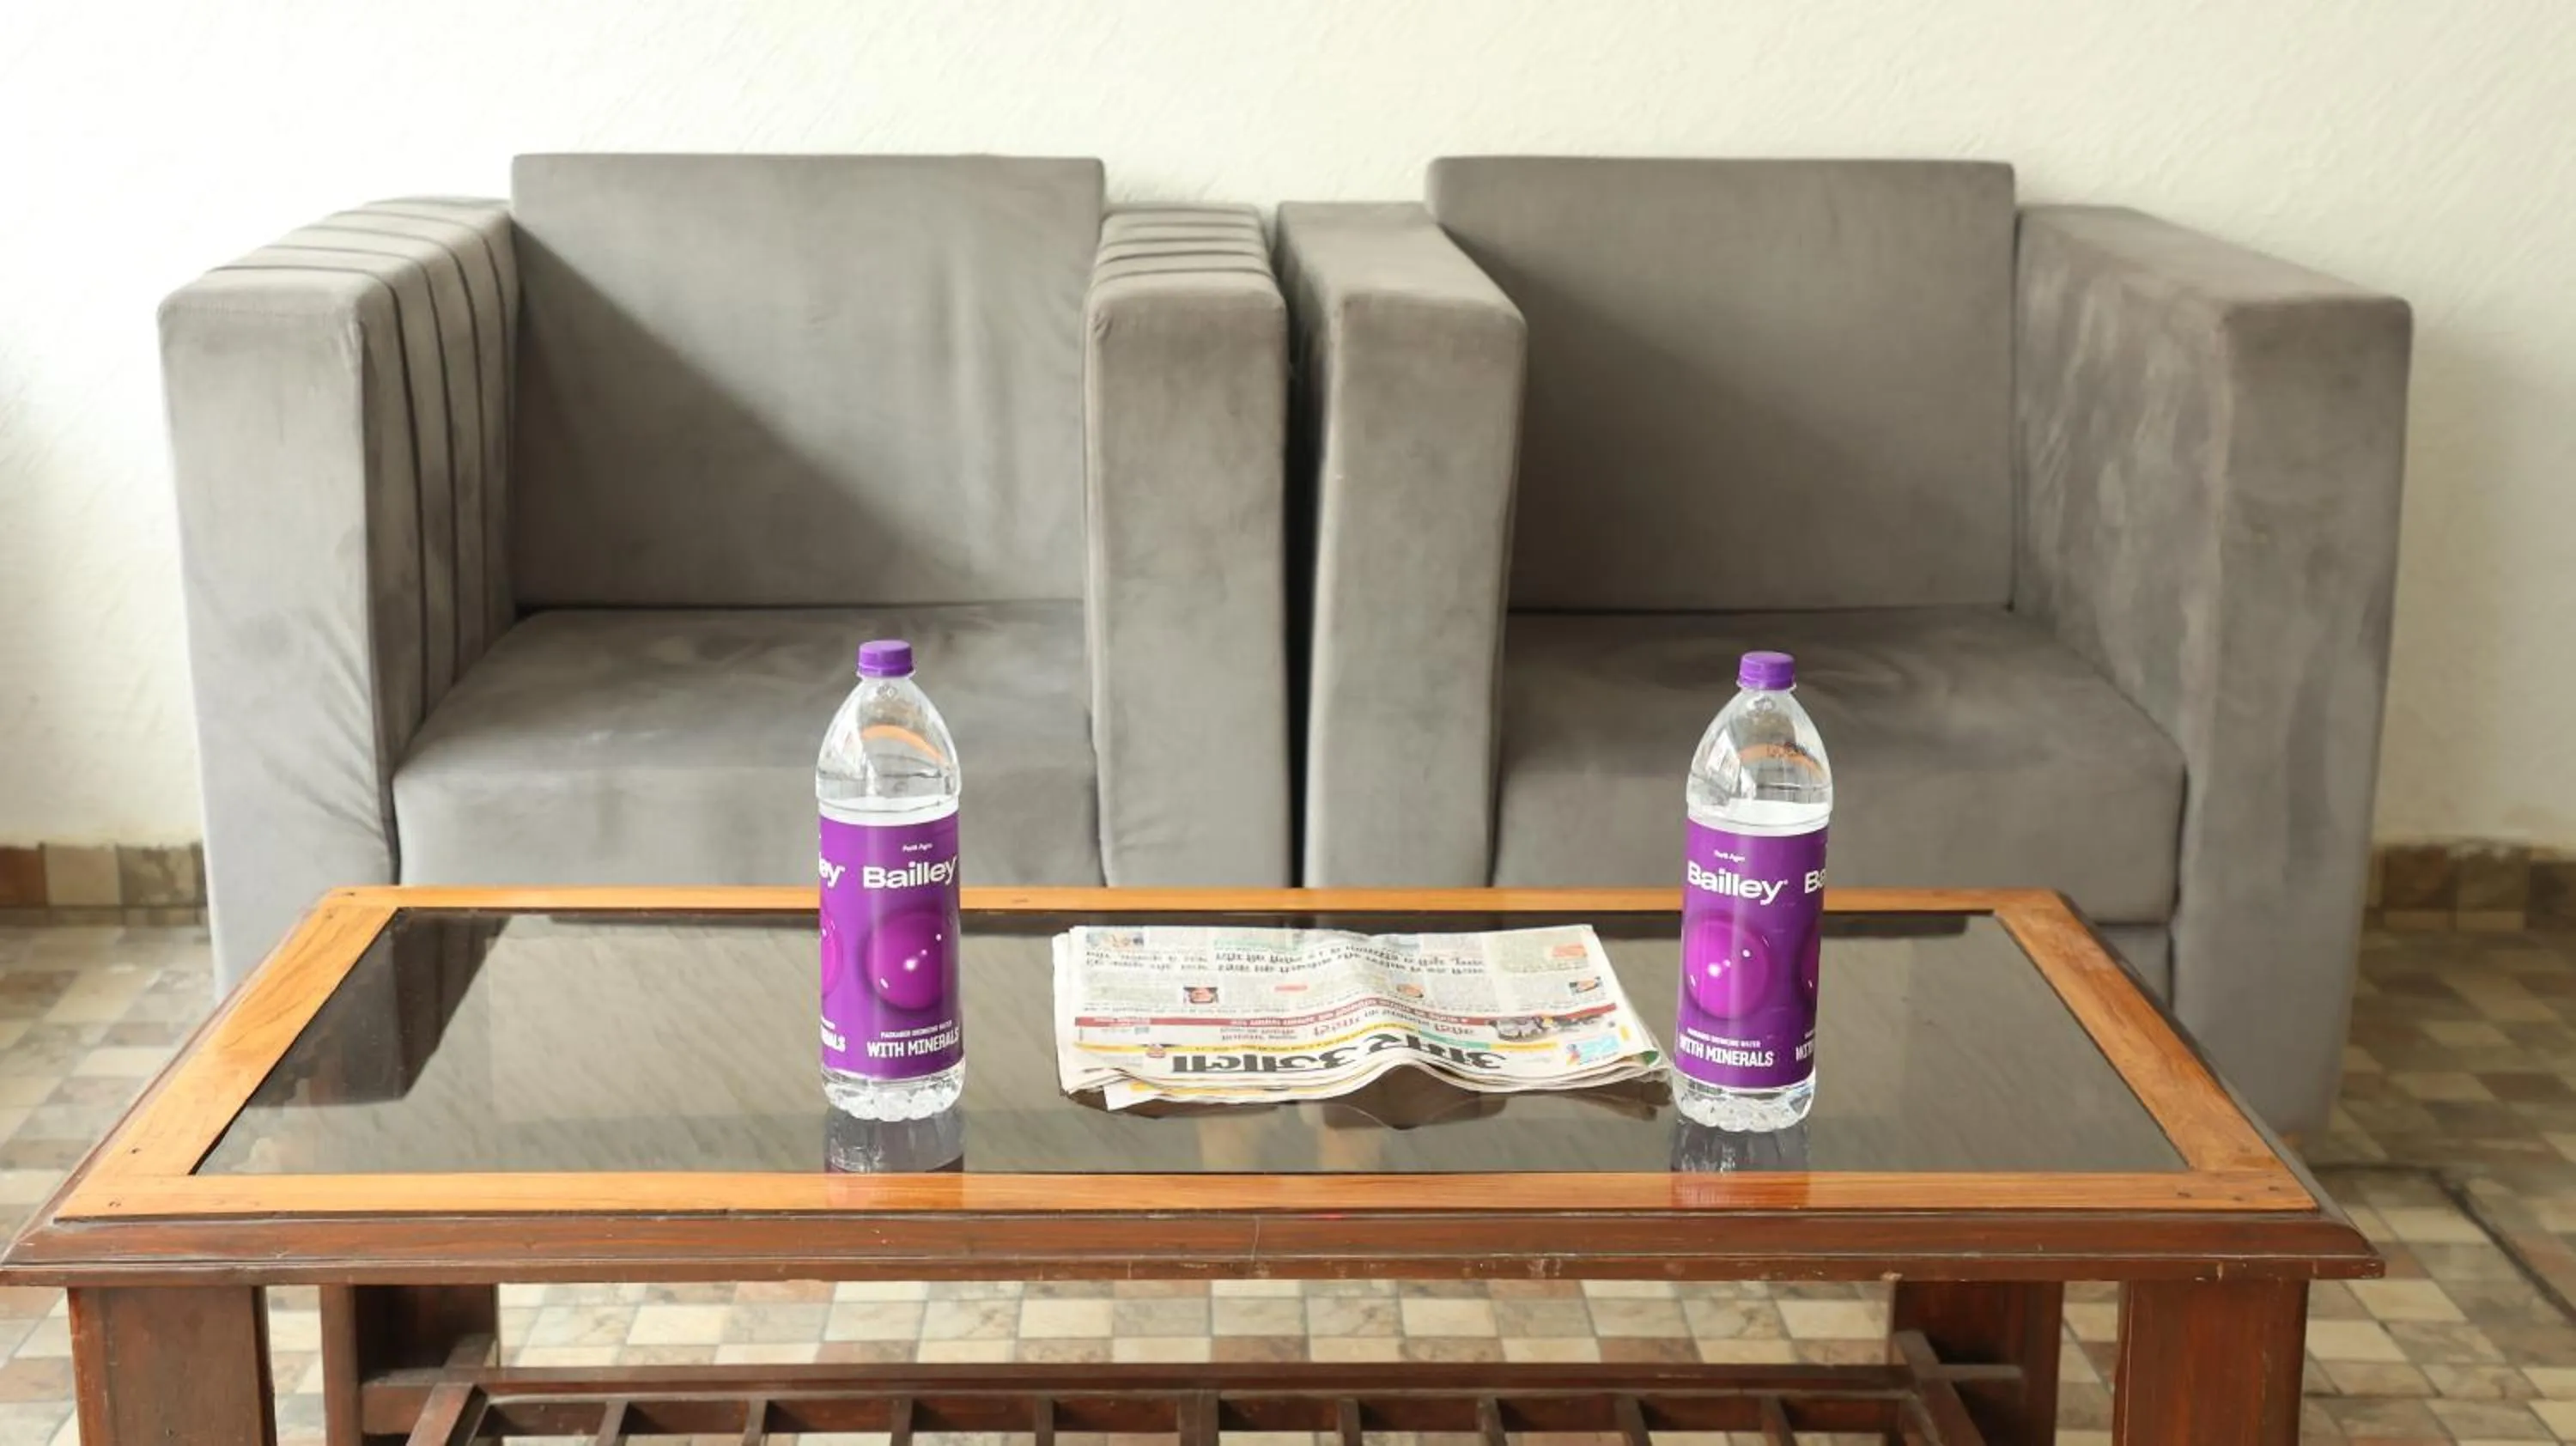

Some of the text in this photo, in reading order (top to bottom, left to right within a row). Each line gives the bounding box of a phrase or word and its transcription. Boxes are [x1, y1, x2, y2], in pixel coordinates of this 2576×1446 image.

[863, 854, 957, 889] Bailley
[1687, 860, 1783, 906] Bailley
[866, 1026, 959, 1058] WITH MINERALS
[1171, 1045, 1360, 1072] उजाला
[1363, 1033, 1505, 1069] अमर
[1679, 1032, 1775, 1067] WITH MINERALS
